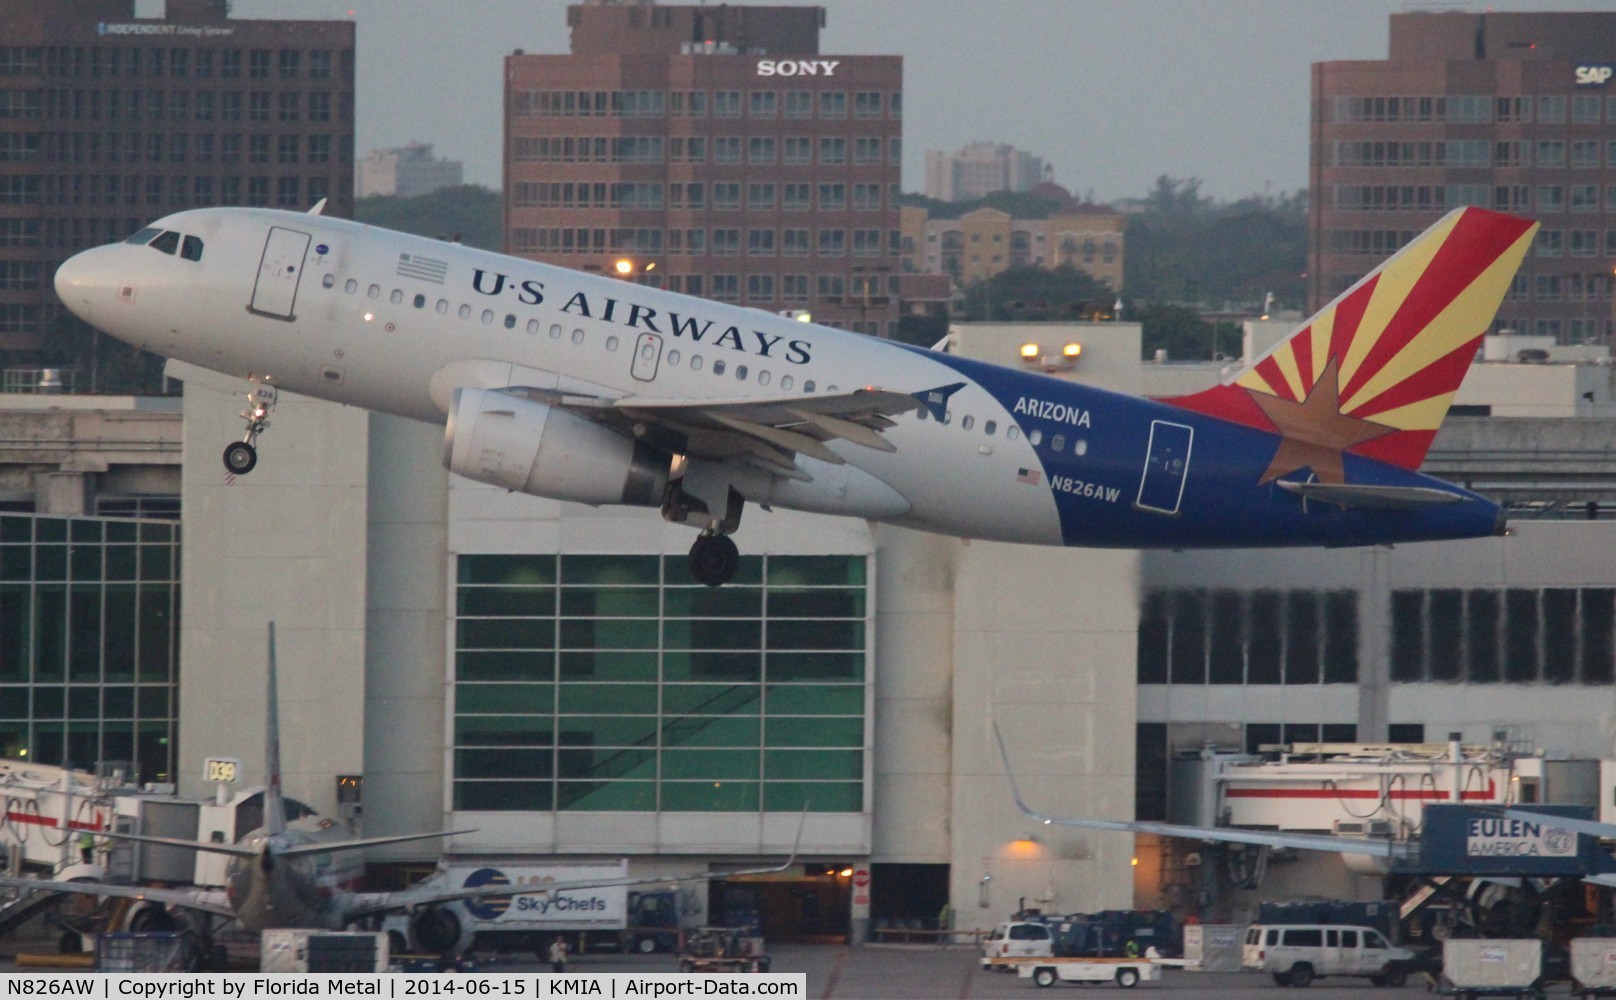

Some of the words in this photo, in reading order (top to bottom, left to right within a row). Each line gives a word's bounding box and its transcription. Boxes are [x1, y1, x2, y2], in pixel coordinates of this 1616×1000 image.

[757, 60, 839, 76] SONY
[1575, 66, 1612, 84] SAP
[559, 292, 812, 365] AIRWAYS
[257, 389, 273, 399] 826
[1014, 396, 1091, 428] ARIZONA
[1051, 475, 1120, 503] N826AW
[210, 761, 236, 781] D39
[1469, 819, 1540, 837] EULEN
[1469, 841, 1540, 856] AMERICA
[517, 896, 549, 914] Sky
[555, 896, 606, 911] Chefs
